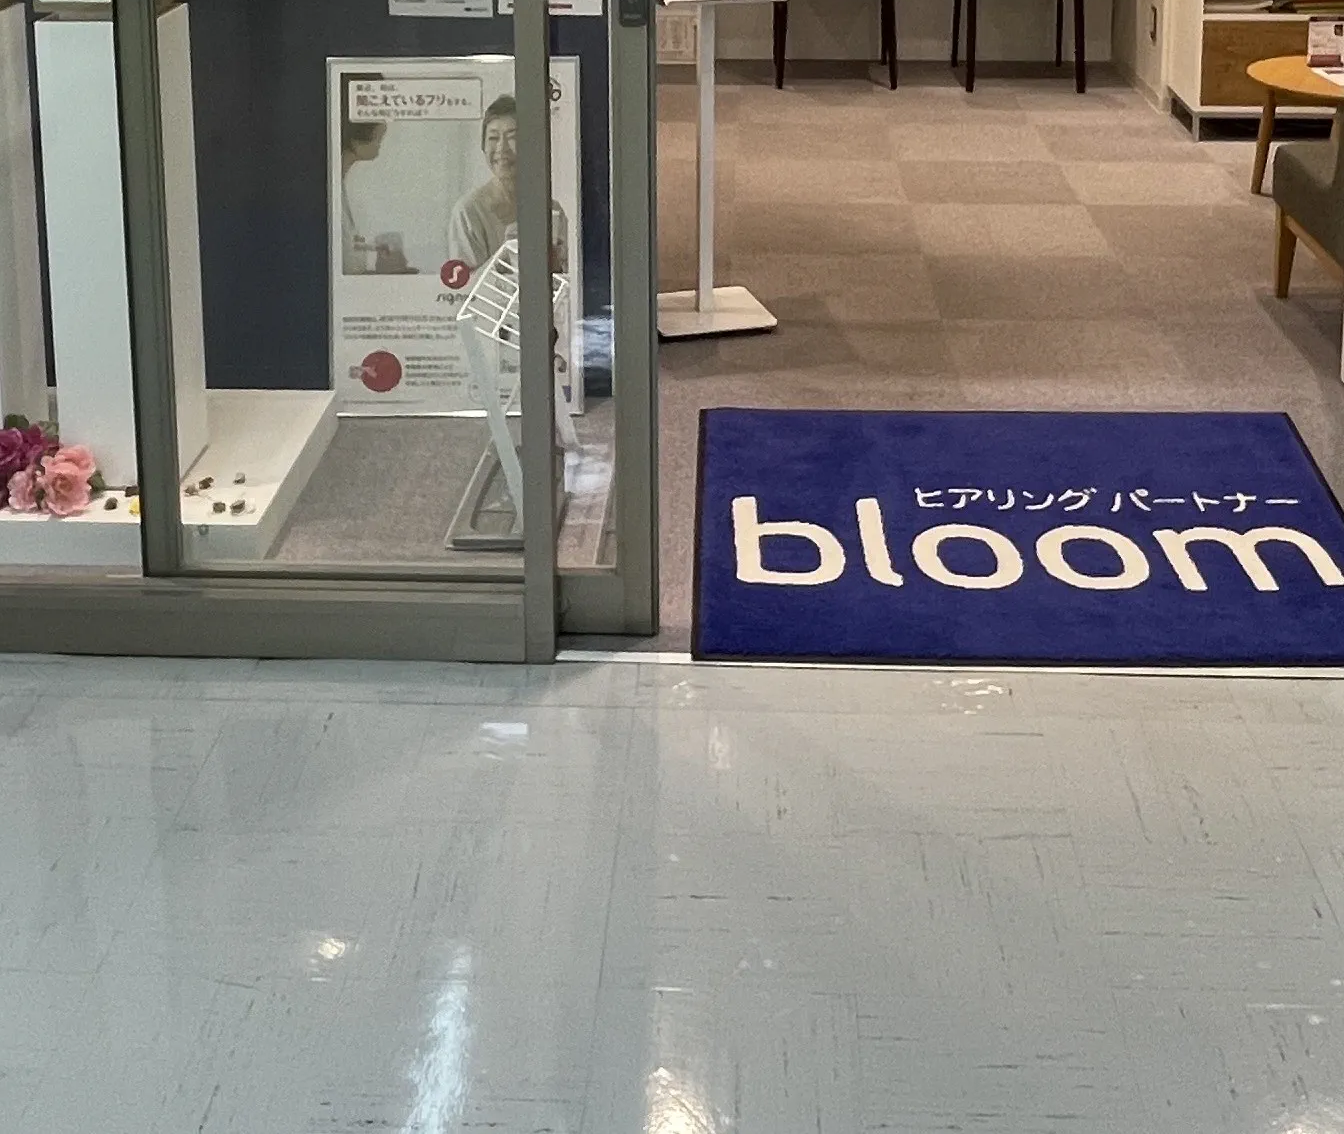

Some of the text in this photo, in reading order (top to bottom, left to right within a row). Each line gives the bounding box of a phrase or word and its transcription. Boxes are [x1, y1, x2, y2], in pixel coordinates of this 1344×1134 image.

[914, 487, 1301, 514] ヒアリング パートナー
